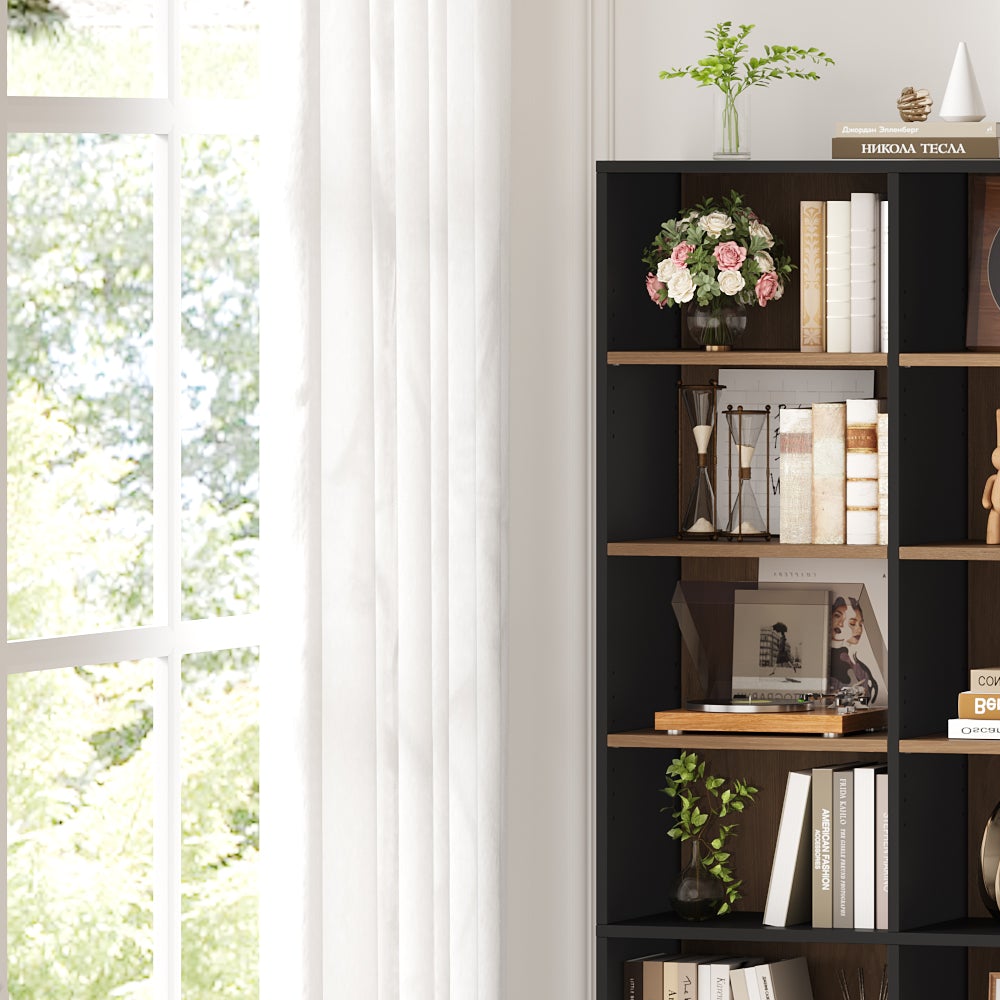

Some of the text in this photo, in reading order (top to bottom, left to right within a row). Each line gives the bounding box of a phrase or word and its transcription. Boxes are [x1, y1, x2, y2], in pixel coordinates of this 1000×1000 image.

[861, 143, 966, 154] НИКОЛА ТЕСЛА
[839, 778, 847, 825] FRIDA KAHLO
[821, 808, 831, 891] AMERICAN FASHION
[681, 975, 692, 994] The
